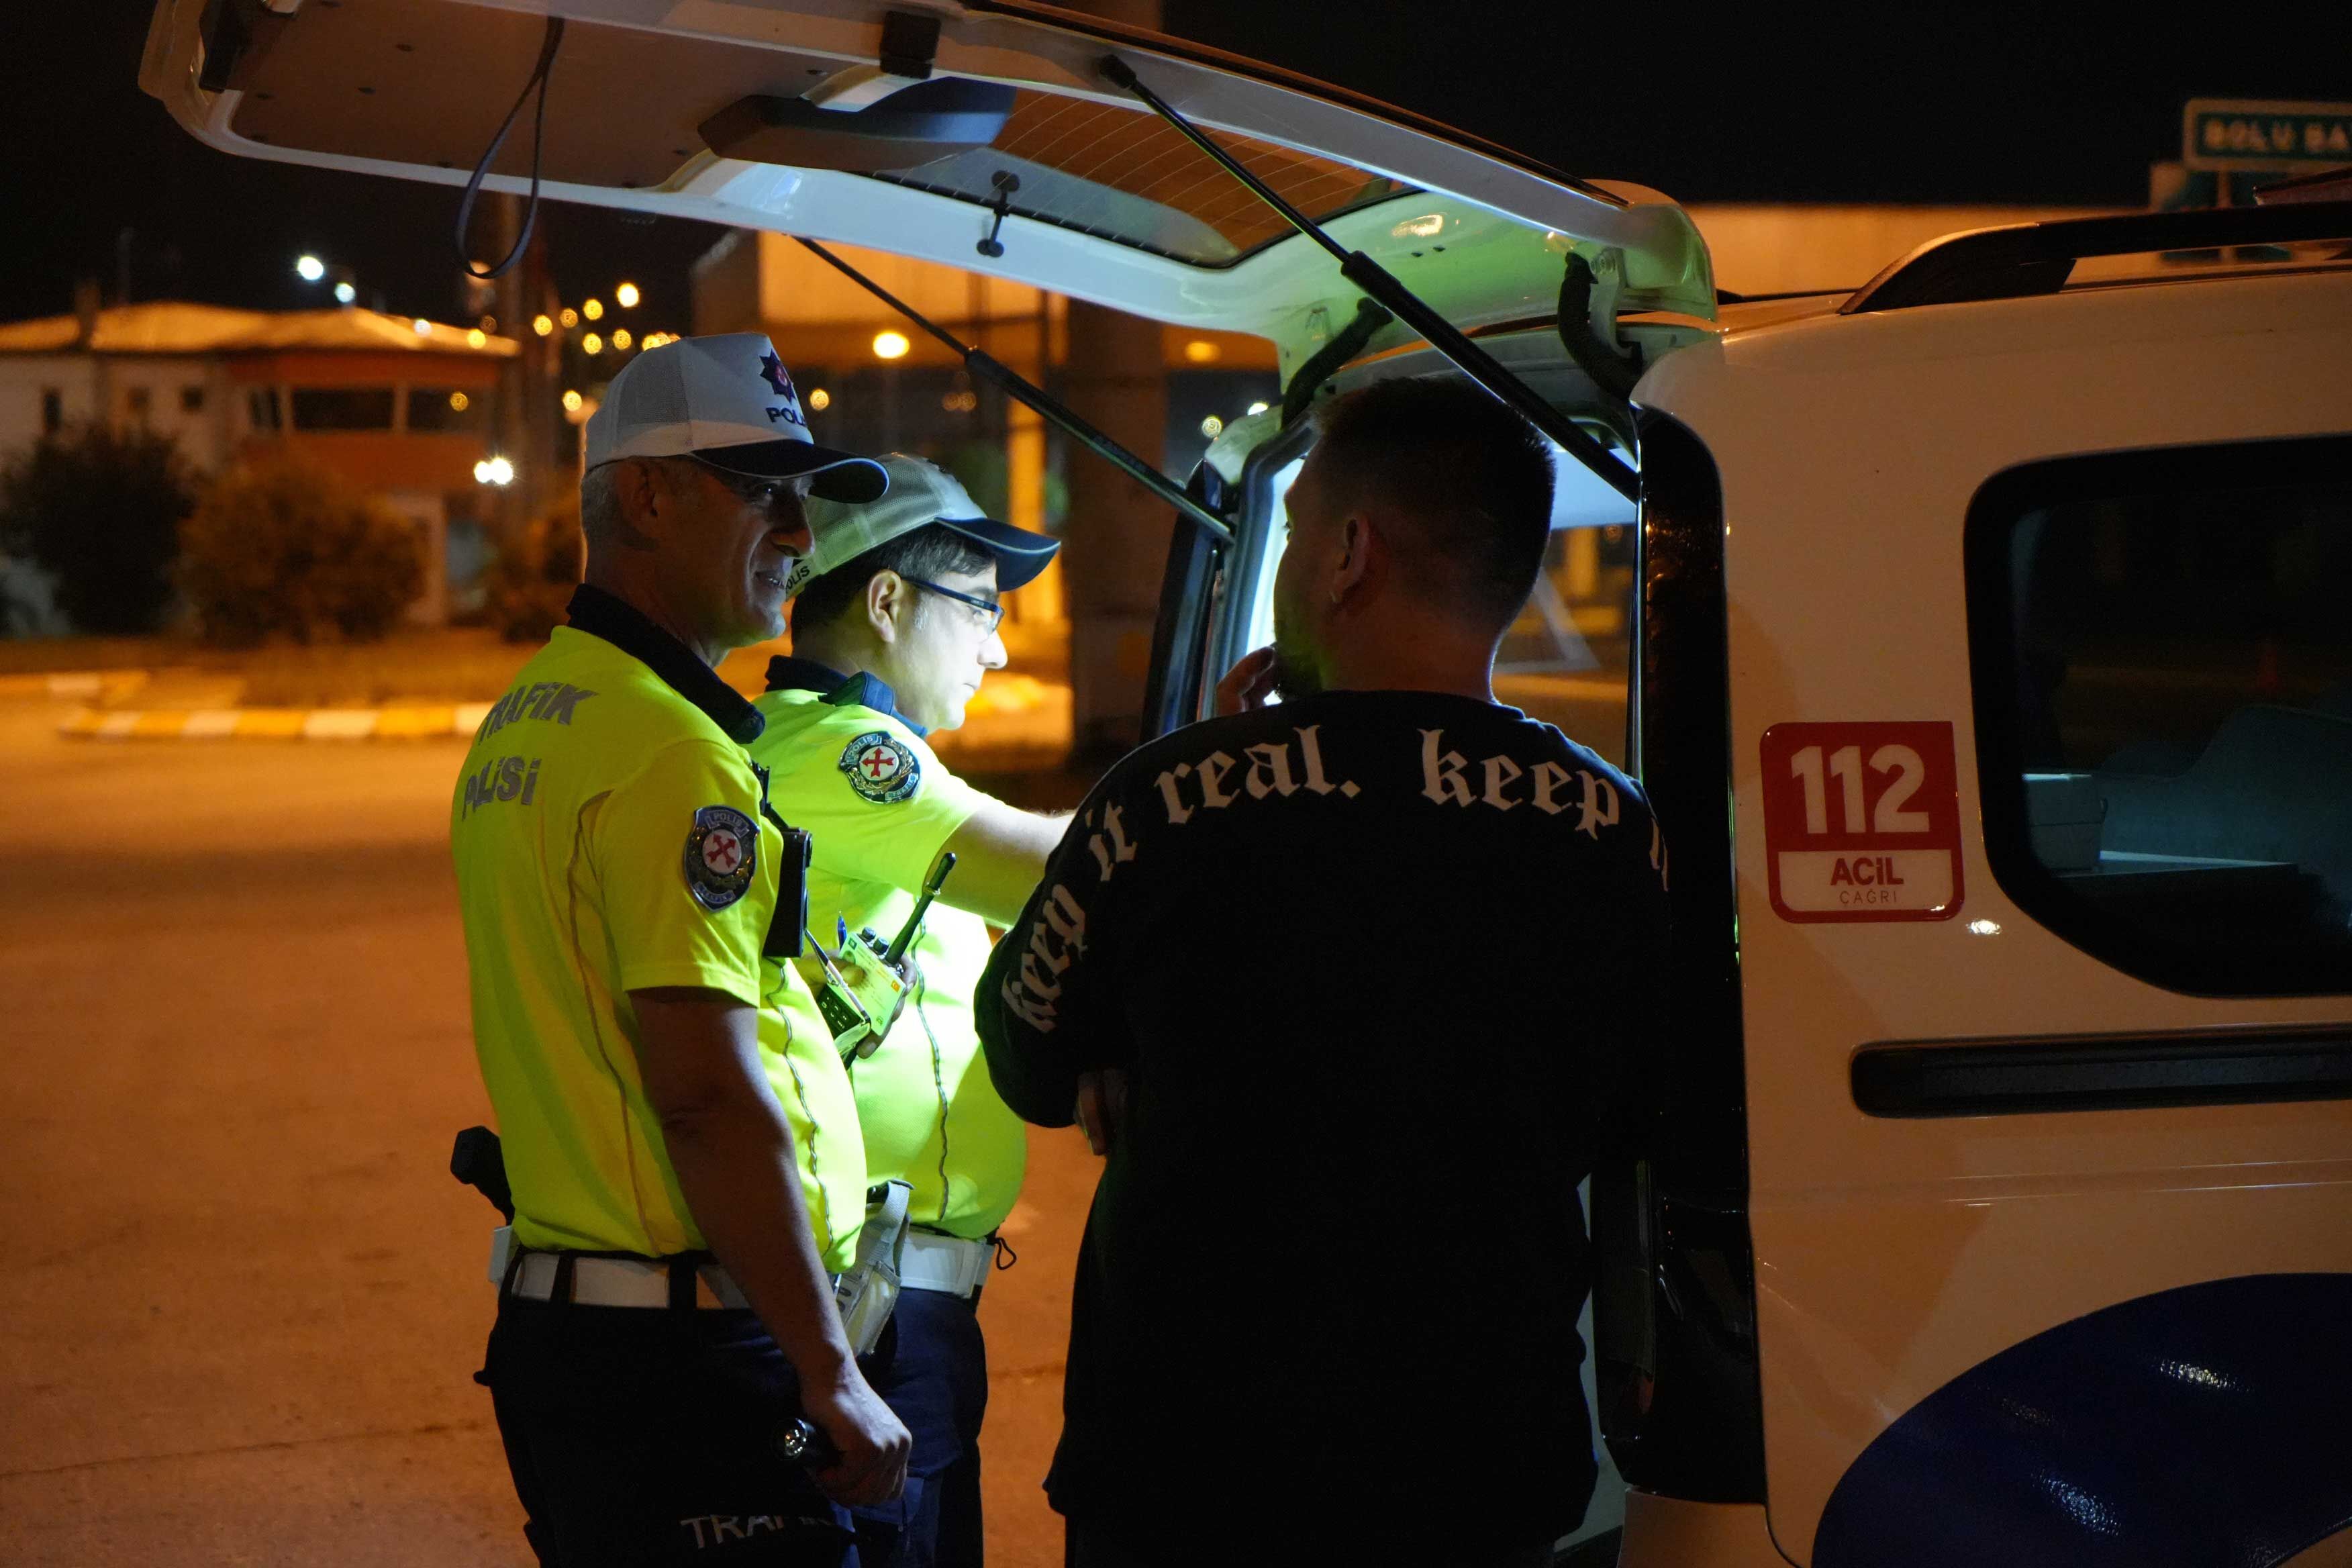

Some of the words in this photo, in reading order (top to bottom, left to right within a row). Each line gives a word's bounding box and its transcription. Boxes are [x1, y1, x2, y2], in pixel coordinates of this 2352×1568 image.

[1003, 884, 1088, 1033] keep
[1085, 799, 1137, 882] it
[1154, 724, 1361, 824] real.
[1417, 728, 1624, 840] keep
[1791, 744, 1930, 834] 112
